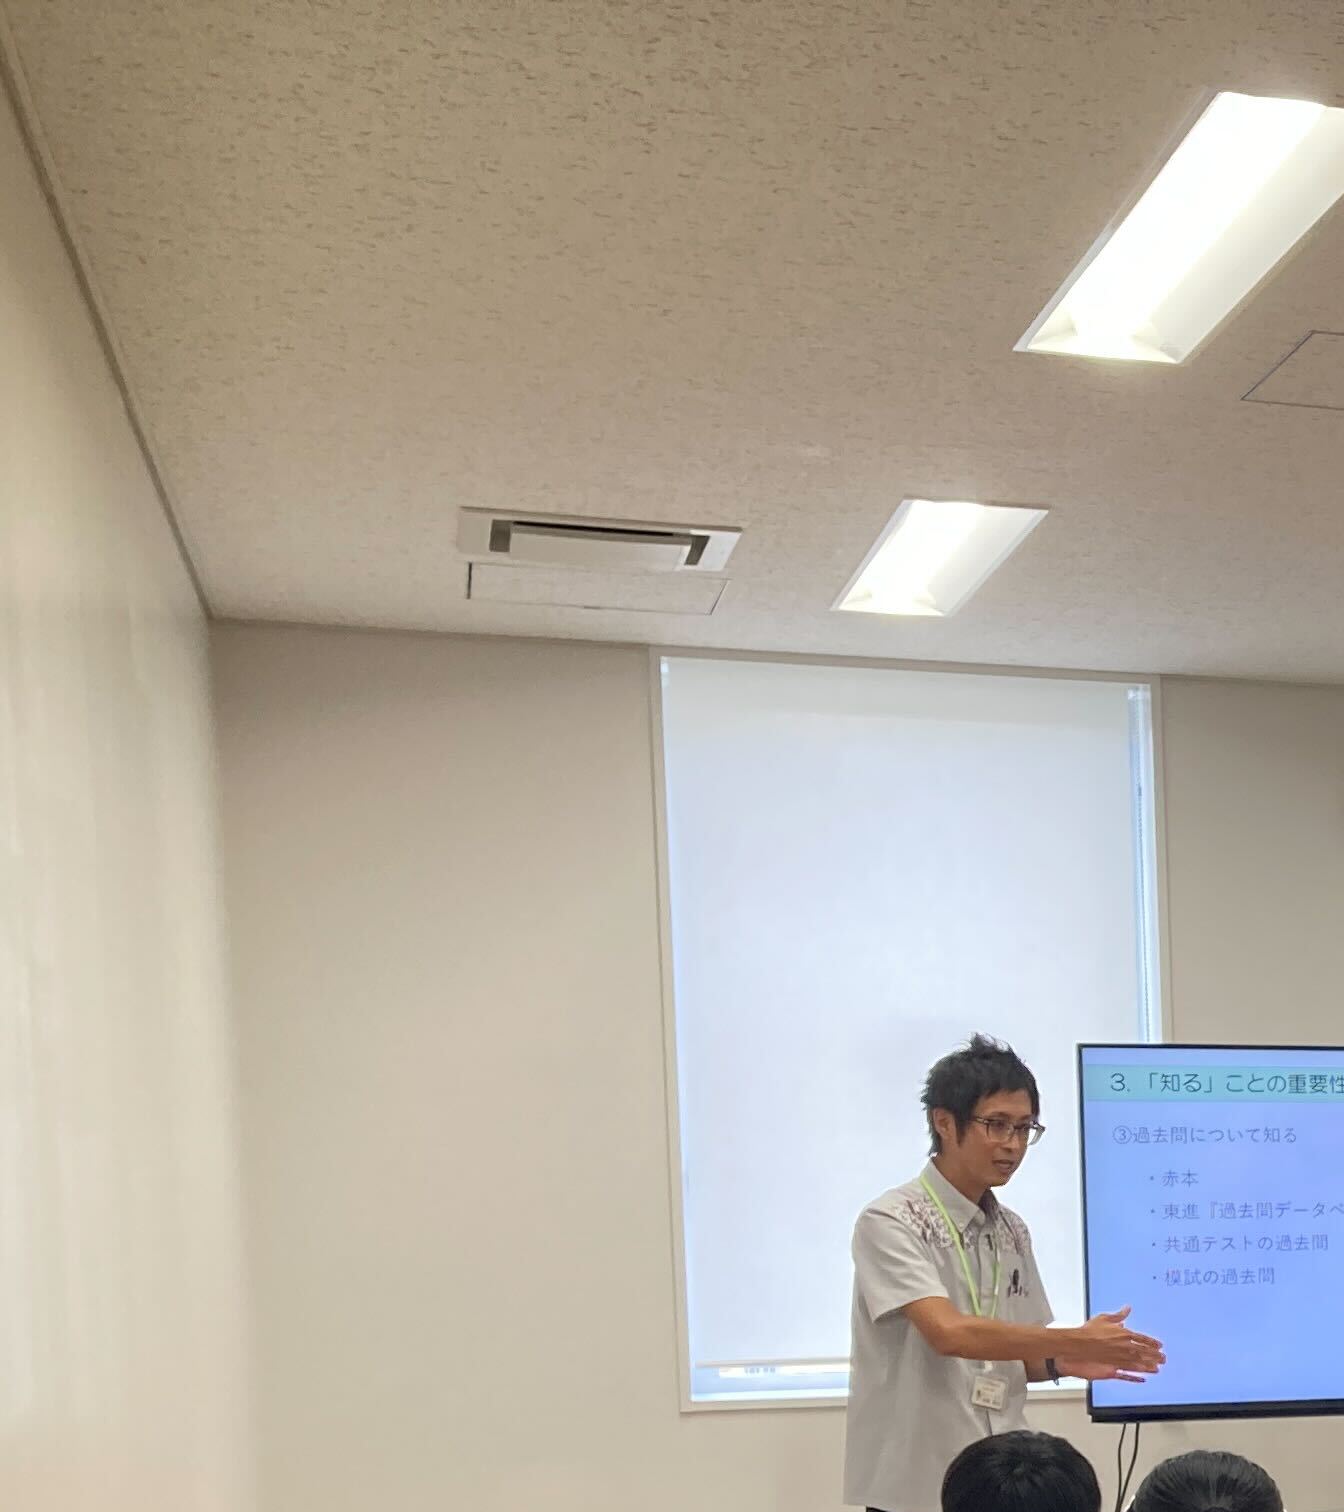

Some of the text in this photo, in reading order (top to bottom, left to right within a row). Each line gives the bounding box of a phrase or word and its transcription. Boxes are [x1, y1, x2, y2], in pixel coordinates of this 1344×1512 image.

[1164, 1233, 1329, 1253] 共通テストの過去問
[1165, 1266, 1276, 1287] 模試の過去問
